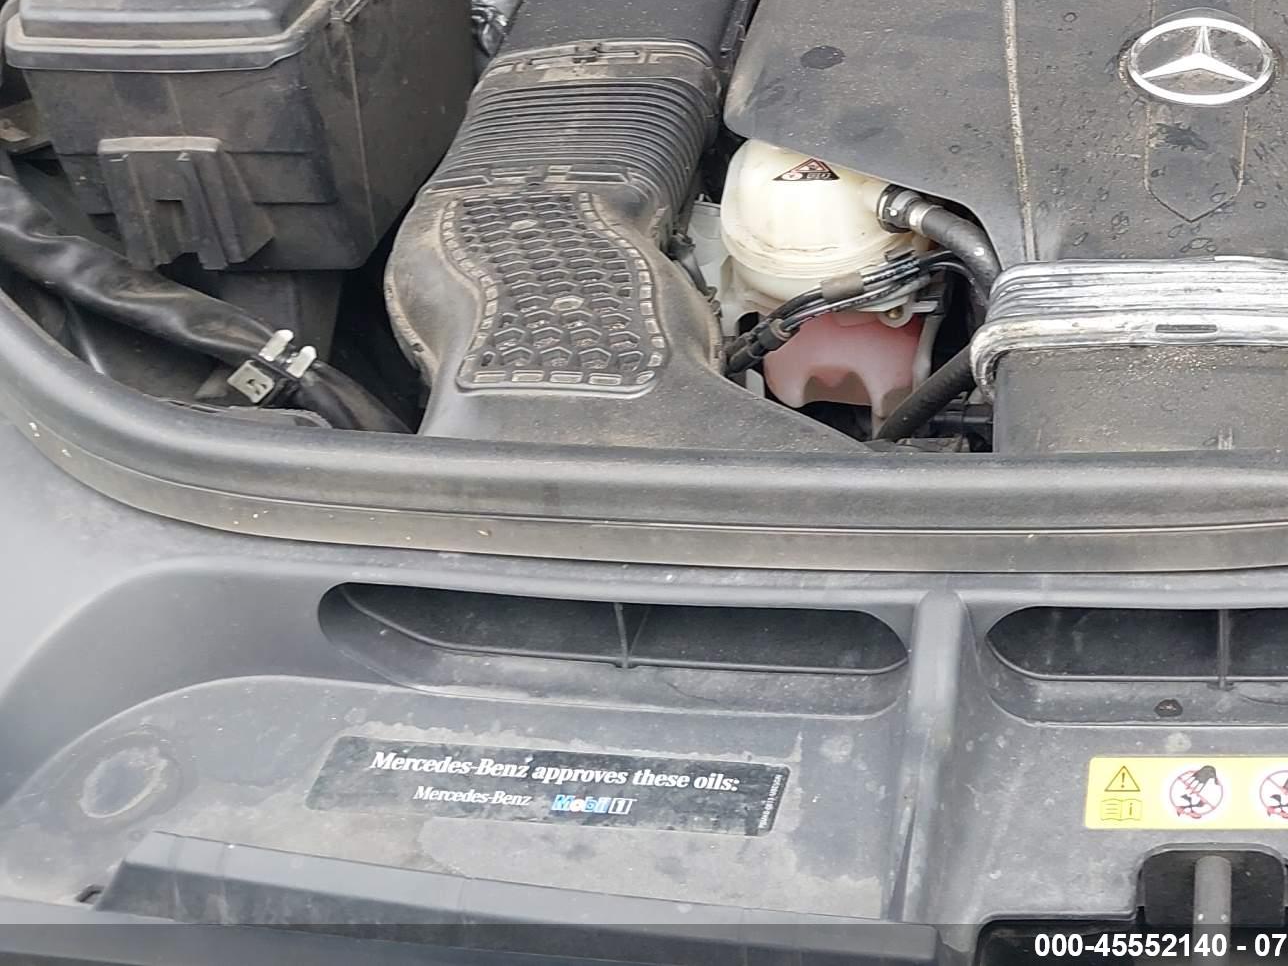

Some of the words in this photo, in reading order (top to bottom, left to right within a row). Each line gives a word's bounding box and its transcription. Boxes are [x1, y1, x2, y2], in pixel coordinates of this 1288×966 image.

[369, 751, 530, 778] Mercedes-Benz
[531, 765, 628, 785] approves
[632, 769, 690, 788] these
[693, 773, 741, 791] oils:
[413, 786, 533, 806] Mercedes-Benz
[551, 793, 611, 814] Mobil
